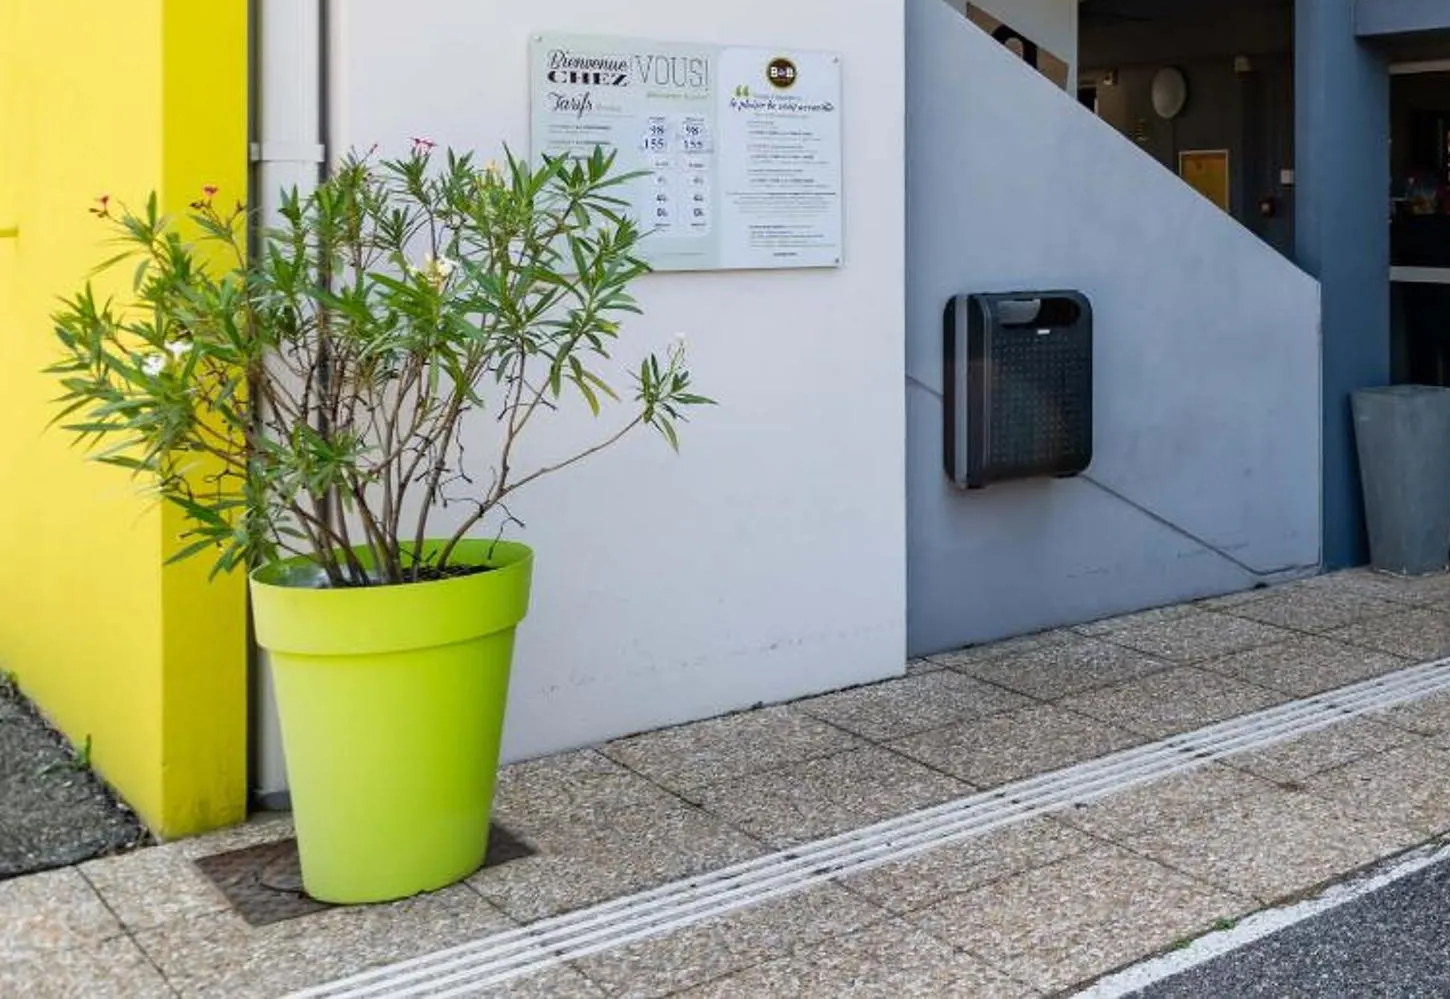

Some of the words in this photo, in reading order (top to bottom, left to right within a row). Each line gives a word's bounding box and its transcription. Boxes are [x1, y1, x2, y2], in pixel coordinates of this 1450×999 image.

[548, 49, 629, 71] Bienvenue
[547, 70, 630, 88] CHEZ
[549, 91, 594, 119] Tarifs
